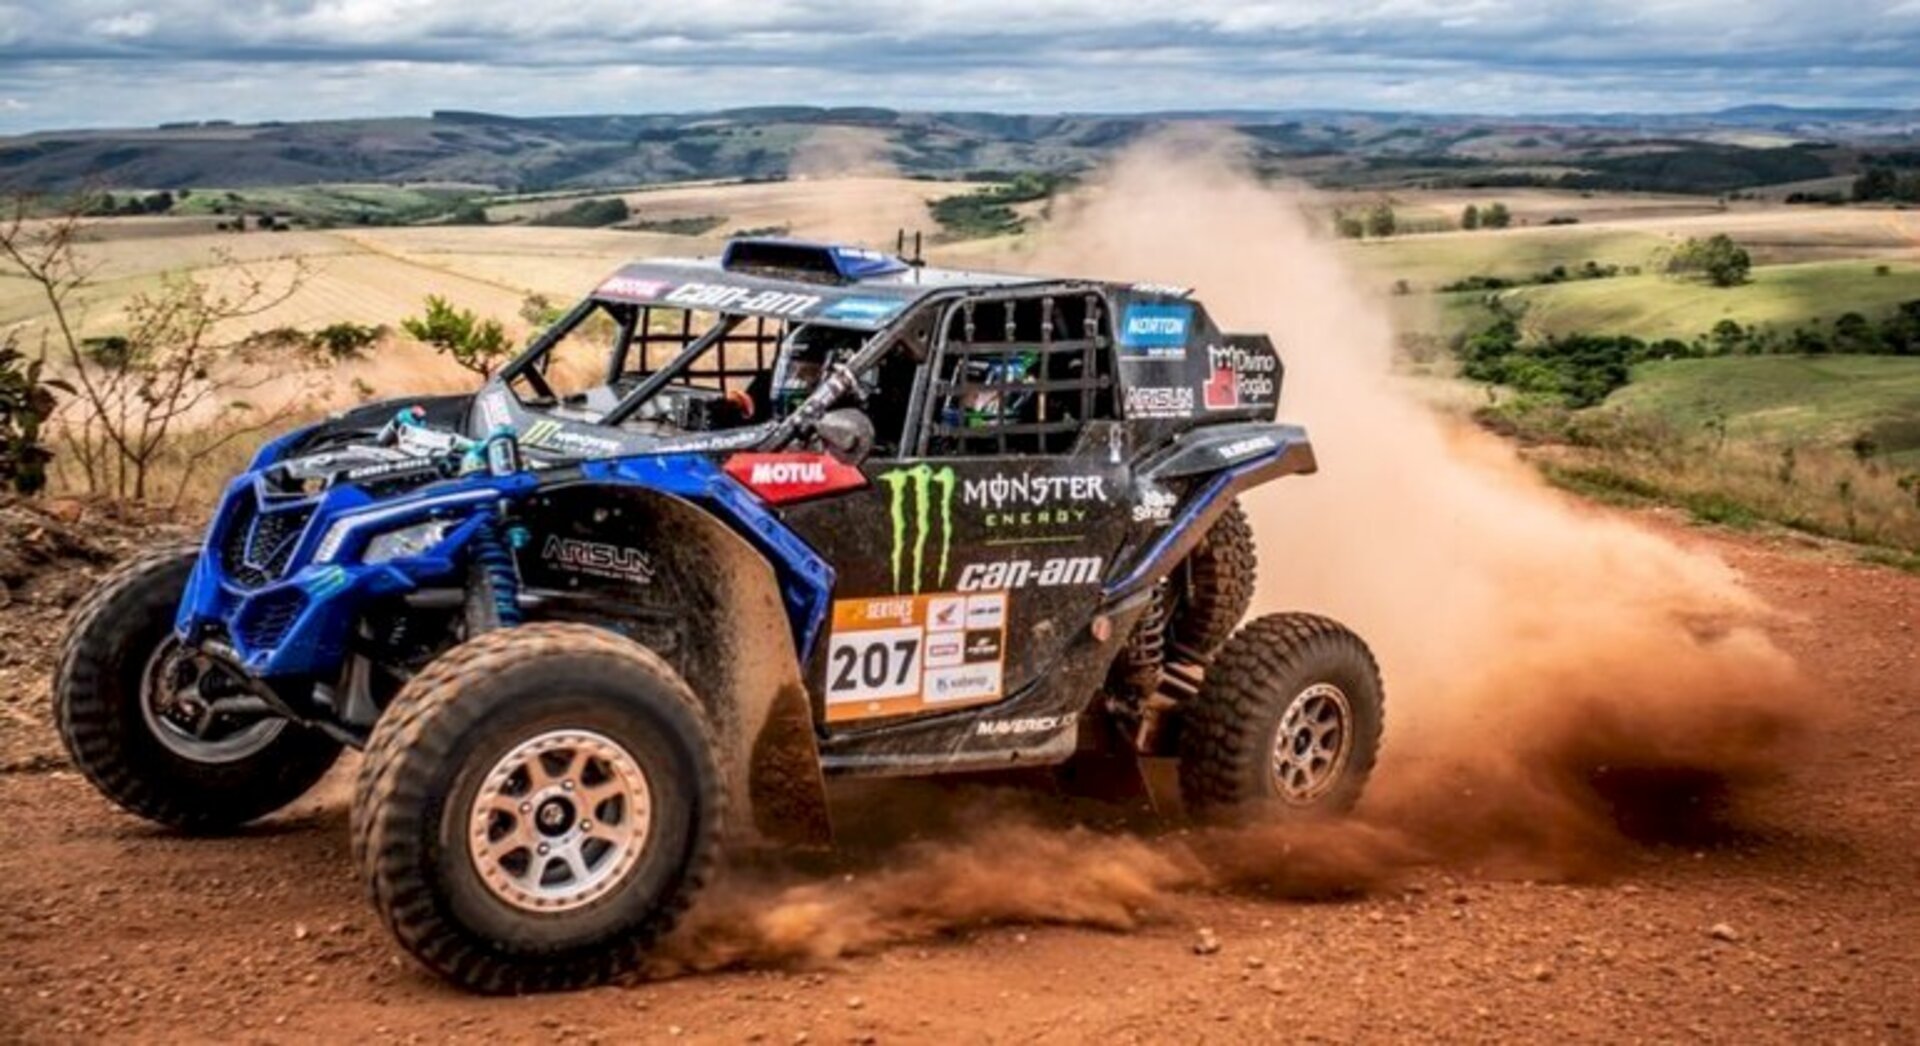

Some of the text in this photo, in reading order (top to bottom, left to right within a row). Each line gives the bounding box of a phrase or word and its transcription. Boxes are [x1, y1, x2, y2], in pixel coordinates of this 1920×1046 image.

[664, 282, 821, 315] can-am
[1128, 317, 1185, 335] NORTON
[750, 462, 826, 485] MOTUL
[963, 472, 1108, 508] MONSTER
[985, 510, 1086, 526] ENERGY
[541, 534, 656, 577] ARISUN
[956, 556, 1103, 592] can-am
[831, 640, 919, 691] 207
